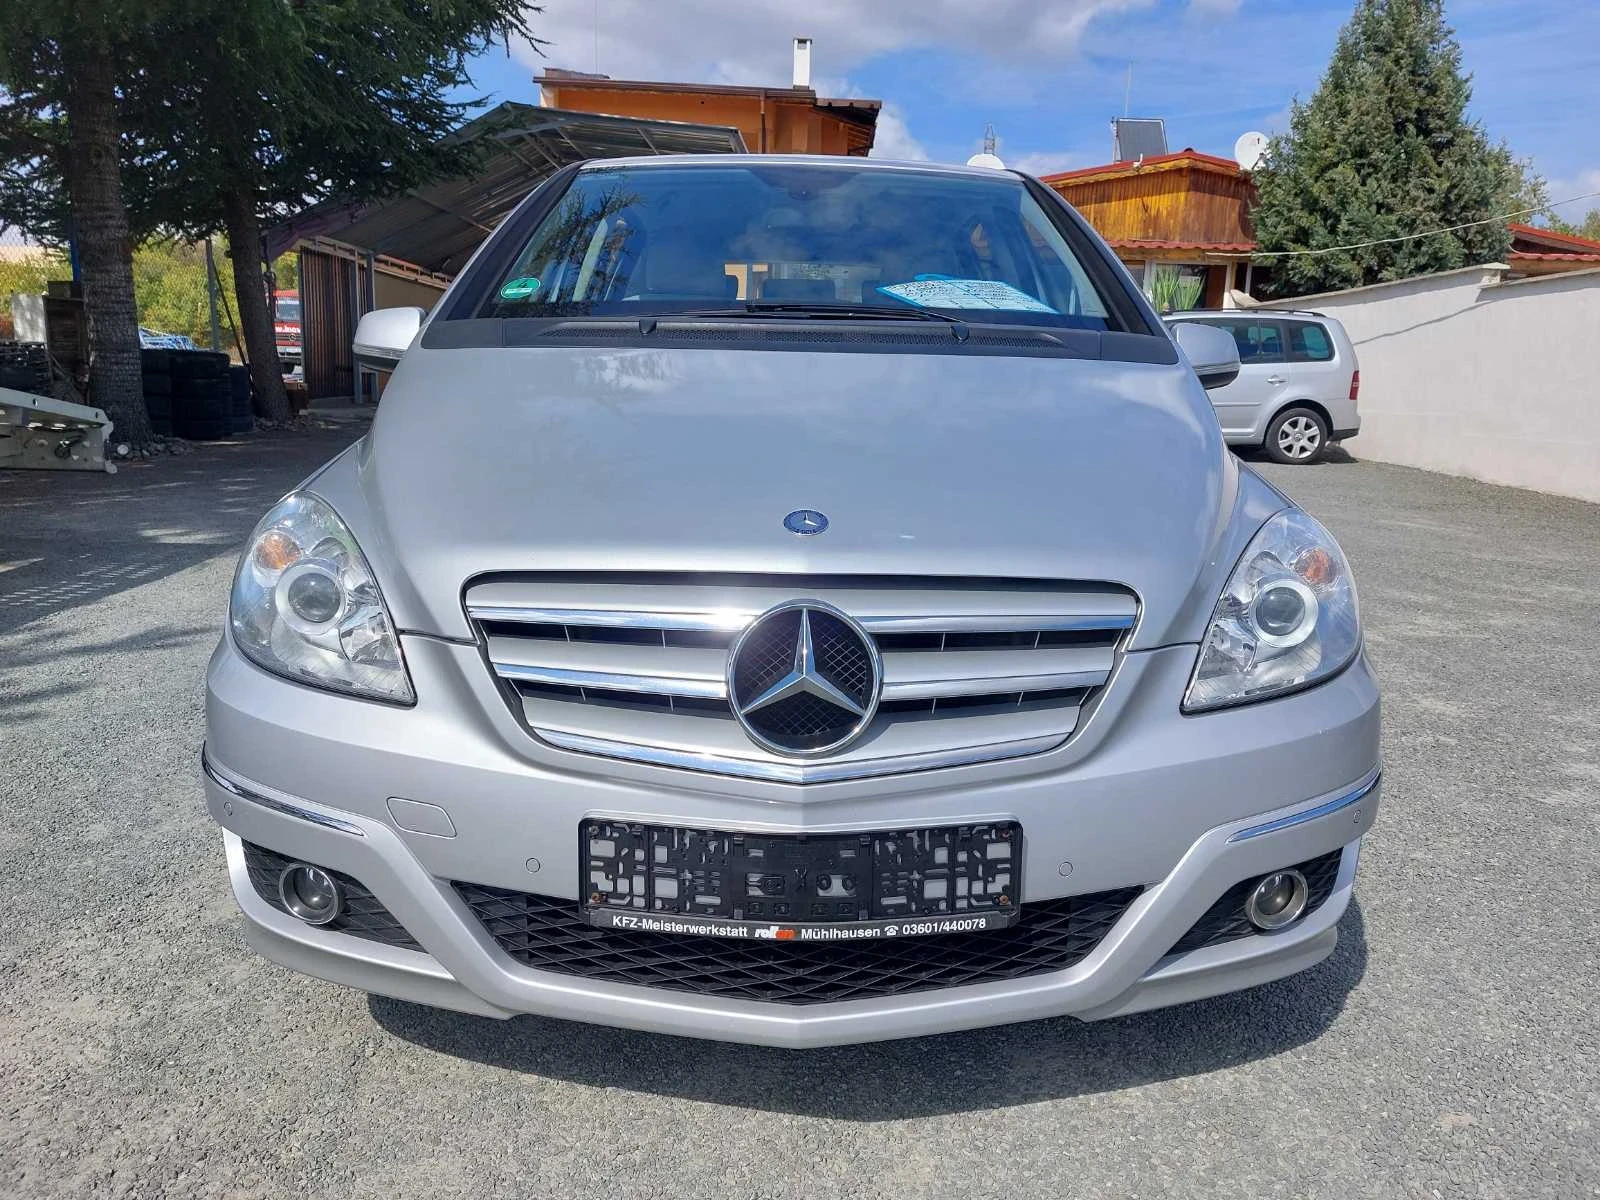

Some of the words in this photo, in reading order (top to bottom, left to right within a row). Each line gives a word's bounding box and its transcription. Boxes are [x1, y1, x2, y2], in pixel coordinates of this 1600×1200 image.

[612, 915, 748, 937] KFZ-Meisterwerkstatt
[801, 927, 881, 940] Mühlhausen
[902, 918, 986, 936] 03601/440078
